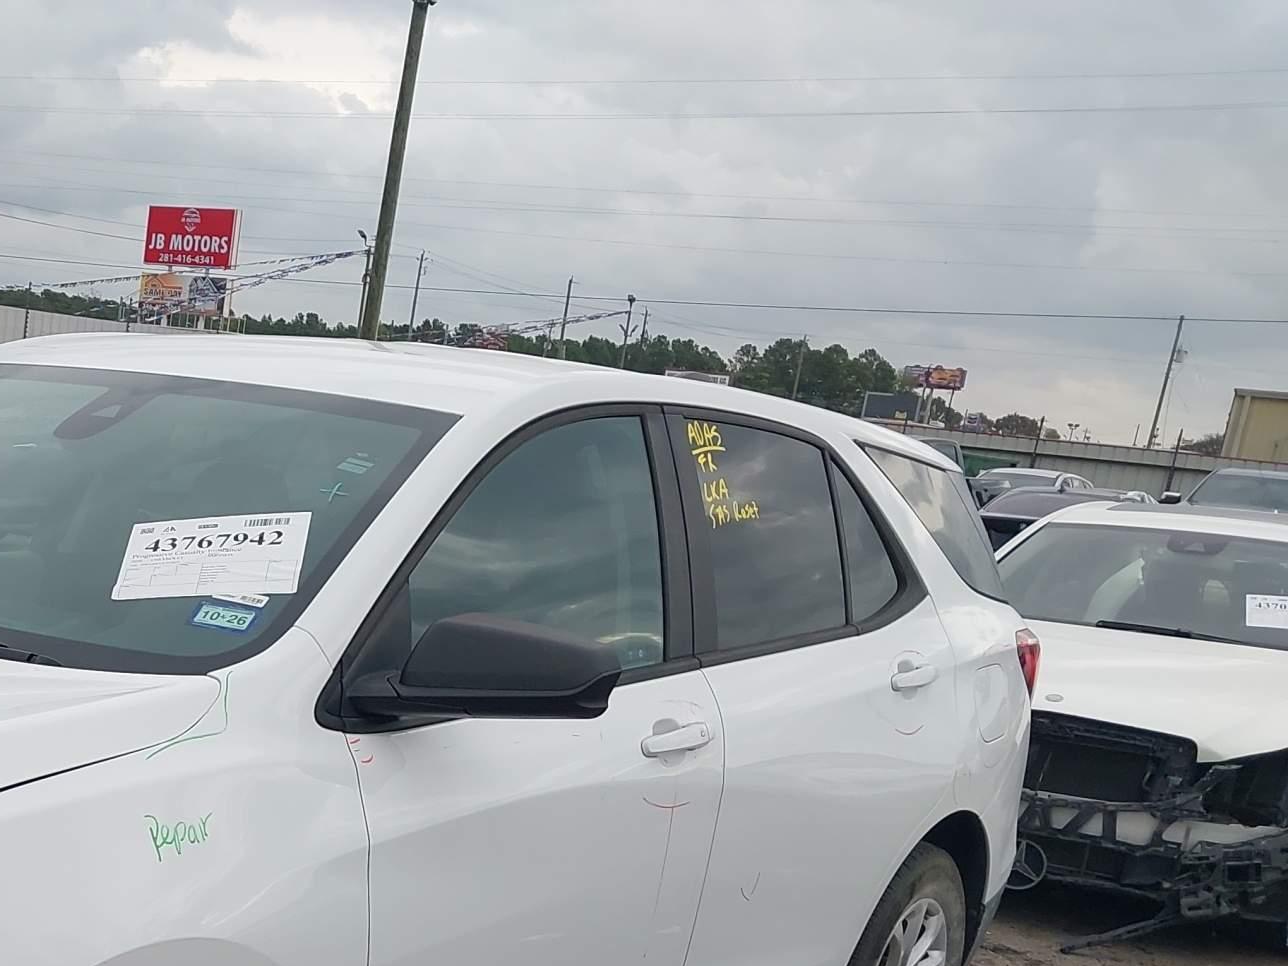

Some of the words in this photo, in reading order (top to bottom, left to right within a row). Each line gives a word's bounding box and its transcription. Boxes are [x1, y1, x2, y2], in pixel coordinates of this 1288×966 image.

[149, 233, 165, 249] JB
[169, 234, 229, 254] MOTORS
[158, 253, 214, 265] 281-416-4341
[703, 478, 729, 502] LKA
[145, 530, 284, 553] 43767942
[144, 812, 213, 862] Repair
